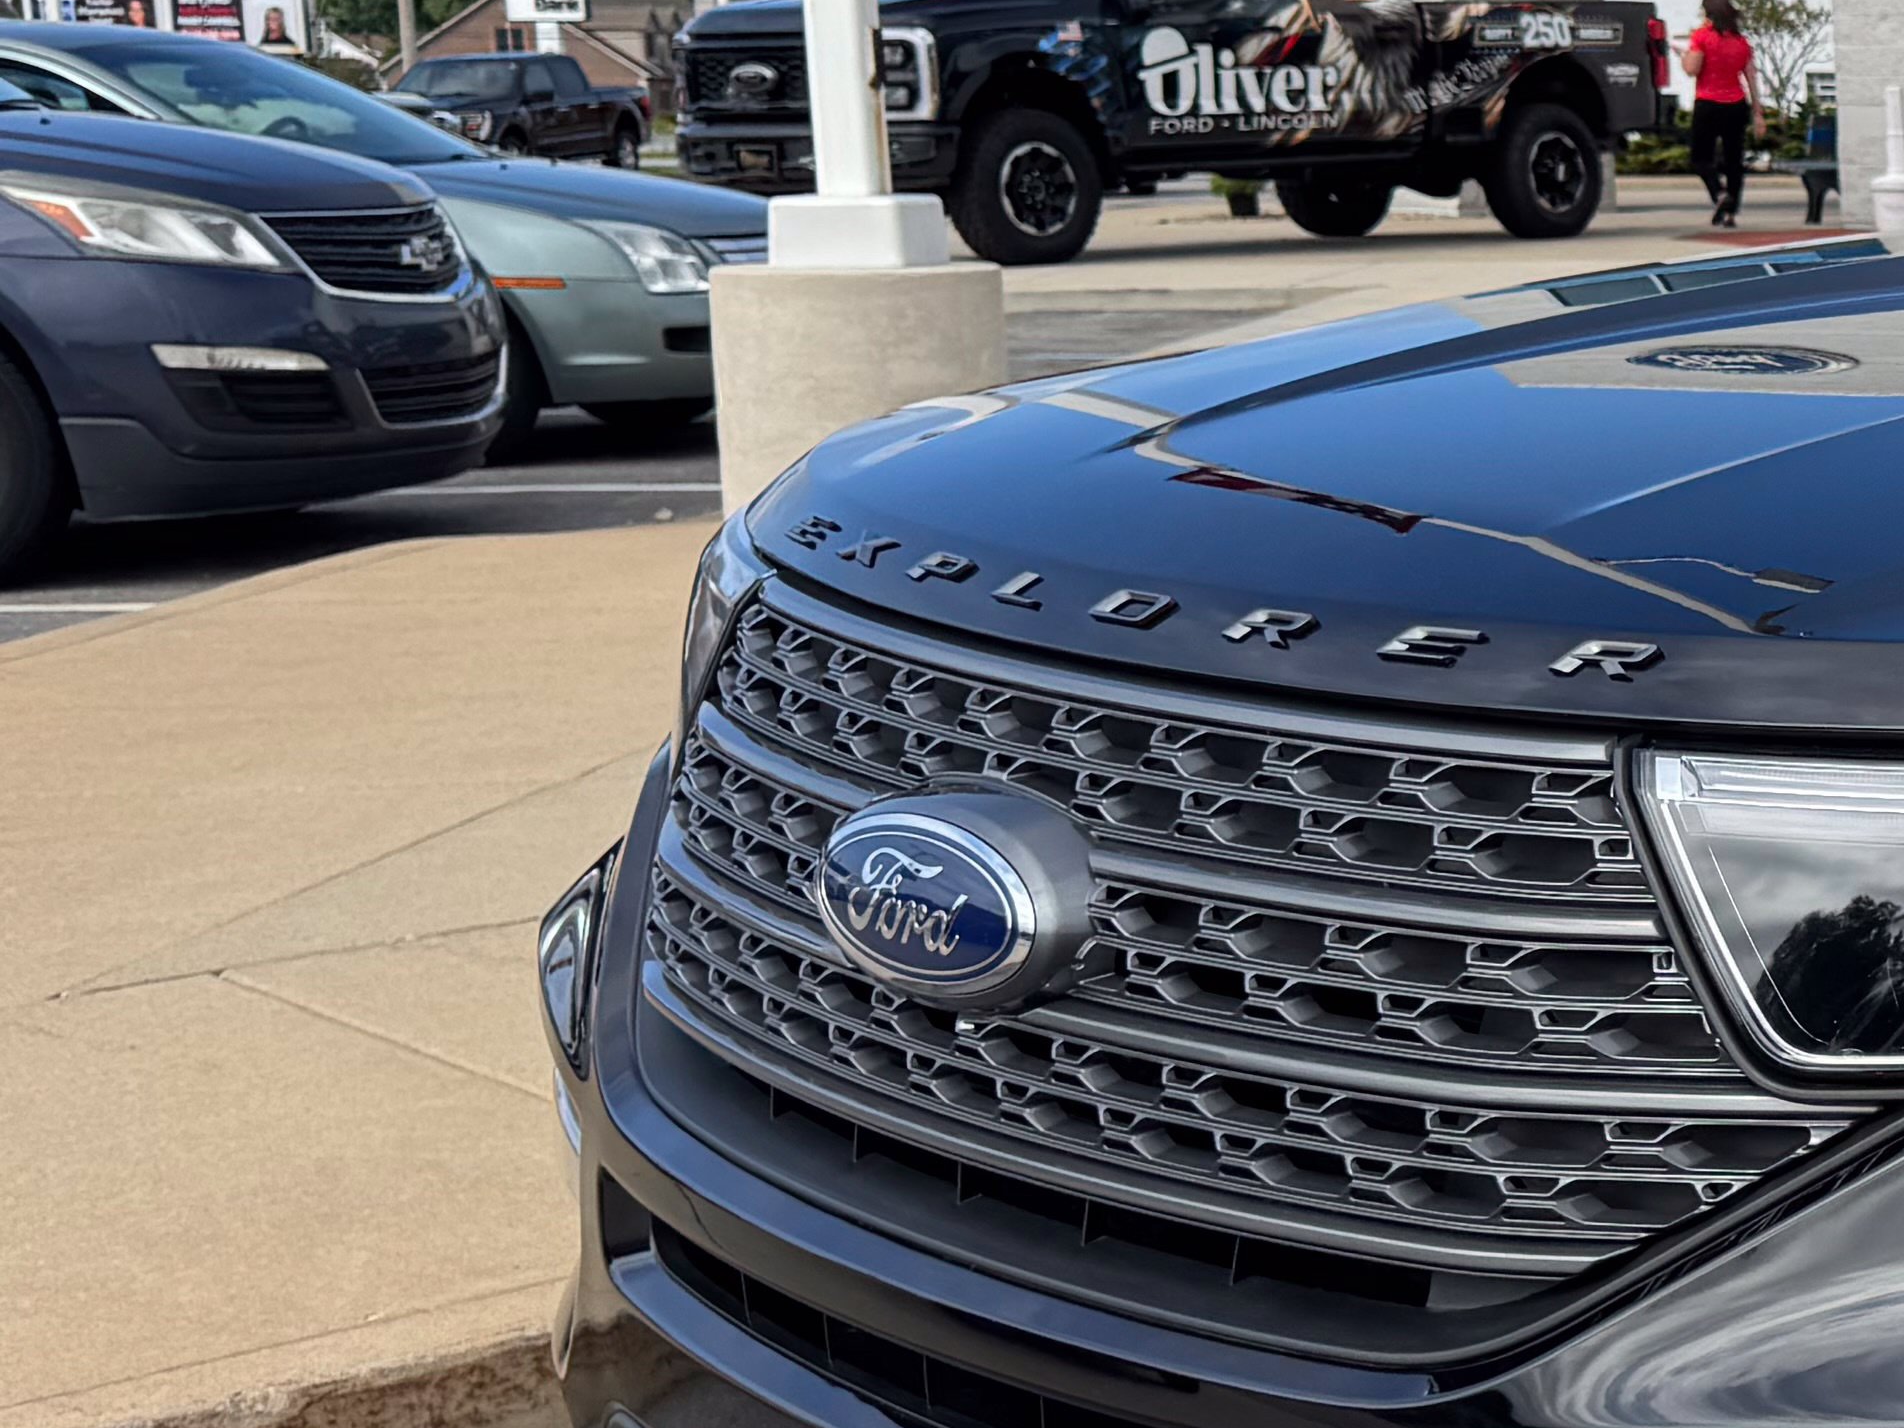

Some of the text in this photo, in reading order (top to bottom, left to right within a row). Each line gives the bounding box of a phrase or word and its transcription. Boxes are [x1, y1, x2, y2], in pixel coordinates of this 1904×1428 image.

[1136, 25, 1340, 116] Oliver
[1519, 11, 1574, 48] 250
[1149, 113, 1340, 135] FORD LINCOLN
[785, 512, 1667, 683] EXPLORER
[848, 846, 969, 956] Ford
